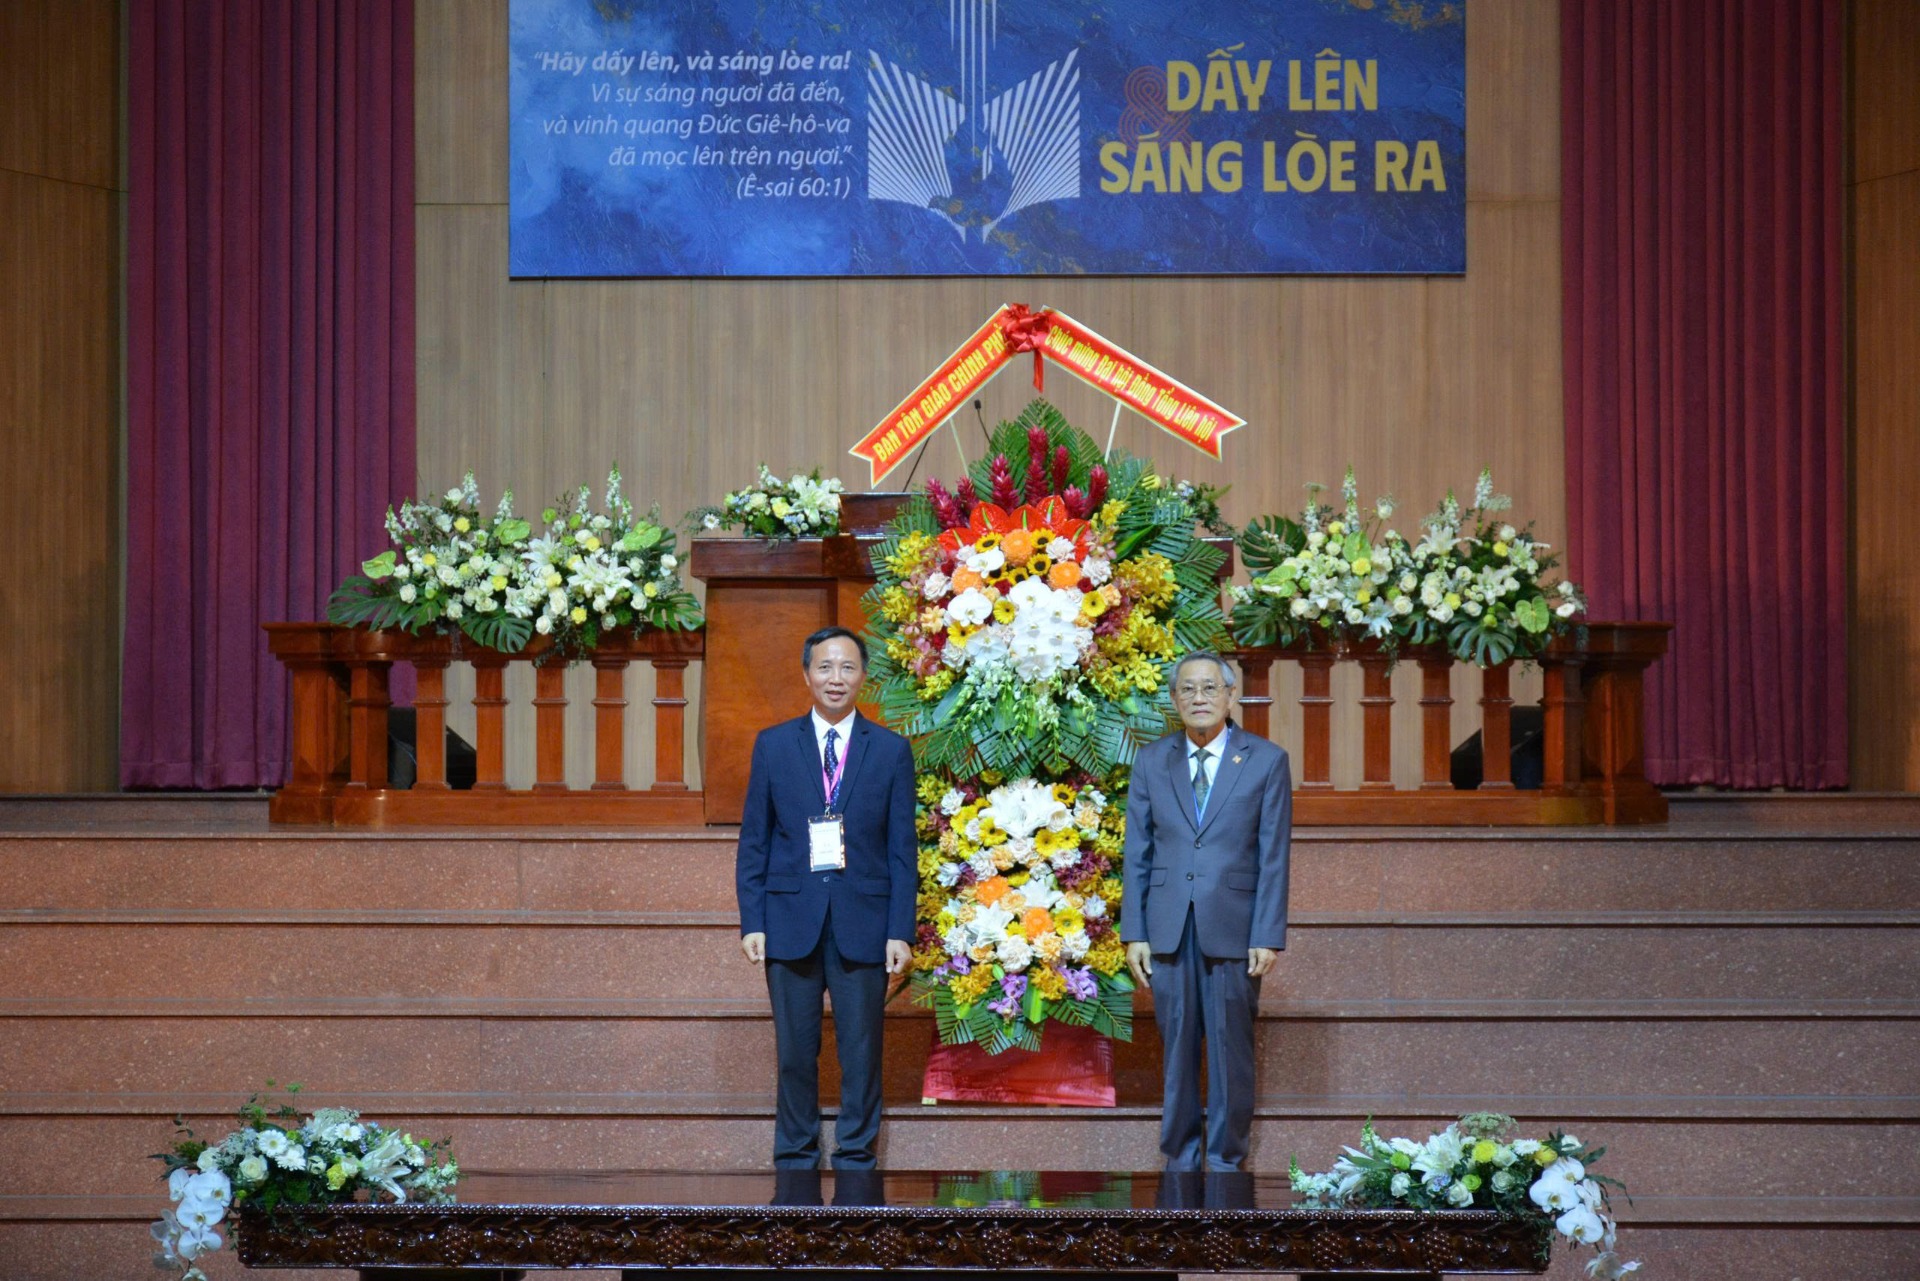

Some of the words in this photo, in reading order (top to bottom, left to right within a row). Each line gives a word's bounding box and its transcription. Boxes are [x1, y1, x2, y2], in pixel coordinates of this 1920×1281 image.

[592, 48, 635, 76] dấy
[639, 50, 680, 73] lên,
[686, 50, 714, 70] và
[718, 50, 774, 75] sáng
[779, 50, 814, 70] lòe
[819, 50, 851, 70] ra!
[1166, 41, 1272, 112] DẤY
[1288, 47, 1378, 111] LÊN
[592, 83, 611, 102] Vì
[615, 85, 642, 107] sự
[644, 83, 696, 107] sáng
[701, 83, 764, 107] ngươi
[767, 81, 795, 102] đã
[801, 79, 845, 104] đến,
[543, 115, 567, 135] và
[573, 114, 618, 135] vinh
[624, 118, 693, 139] quang
[698, 113, 742, 134] Đức
[746, 113, 850, 134] Giê-hô-va
[608, 145, 636, 166] đã
[641, 150, 688, 170] mọc
[693, 145, 724, 166] lên
[730, 145, 771, 165] trên
[1100, 130, 1243, 194] SÁNG
[1263, 130, 1356, 193] LÒE
[1375, 140, 1447, 193] RA
[736, 173, 795, 199] (Ê-sai
[799, 177, 850, 199] 60:1)
[1045, 325, 1074, 355] Chúc
[1068, 341, 1100, 372] mừng
[1151, 386, 1180, 421] Tổng
[1173, 402, 1200, 432] Liên
[1194, 414, 1218, 444] hội
[872, 429, 902, 463] BAN
[896, 412, 925, 440] TÔN
[920, 385, 953, 419] GIÁO
[948, 348, 988, 393] CHÍNH
